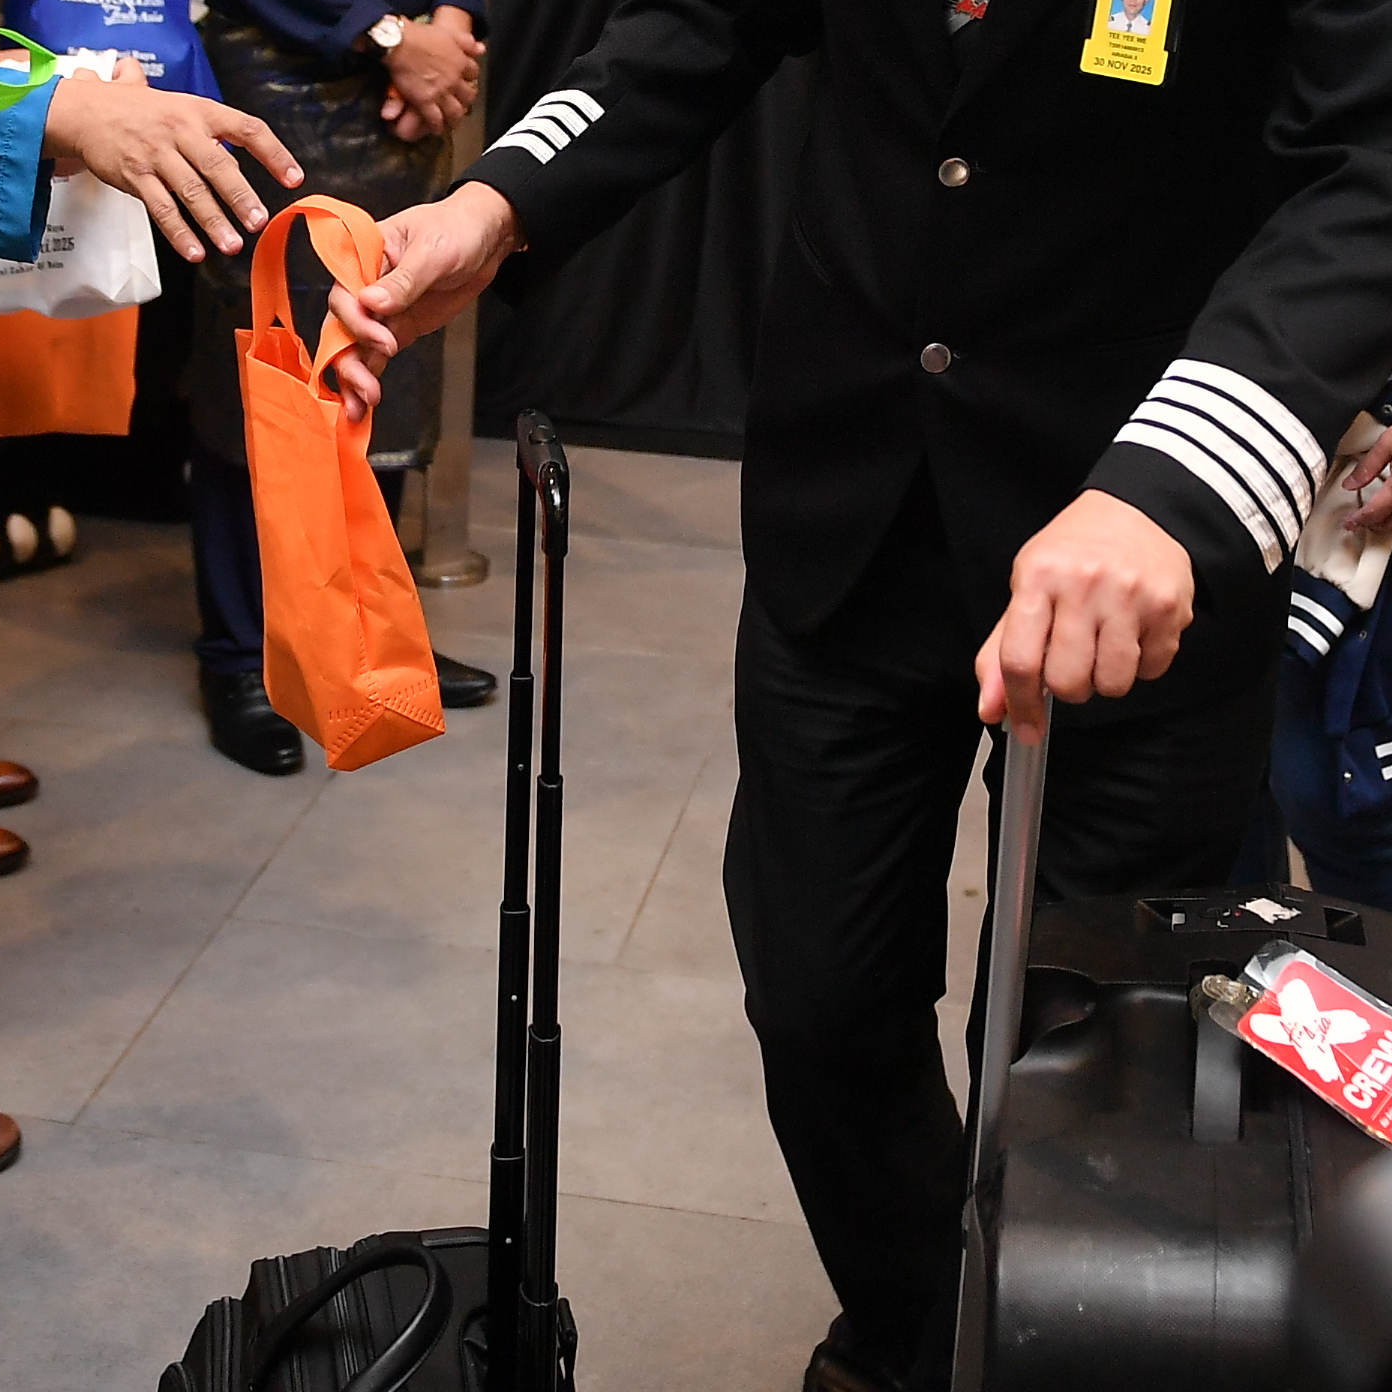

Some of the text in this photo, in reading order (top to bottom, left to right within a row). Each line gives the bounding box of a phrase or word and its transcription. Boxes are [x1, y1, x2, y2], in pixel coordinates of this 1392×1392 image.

[1094, 57, 1152, 75] 30 NOV 2025
